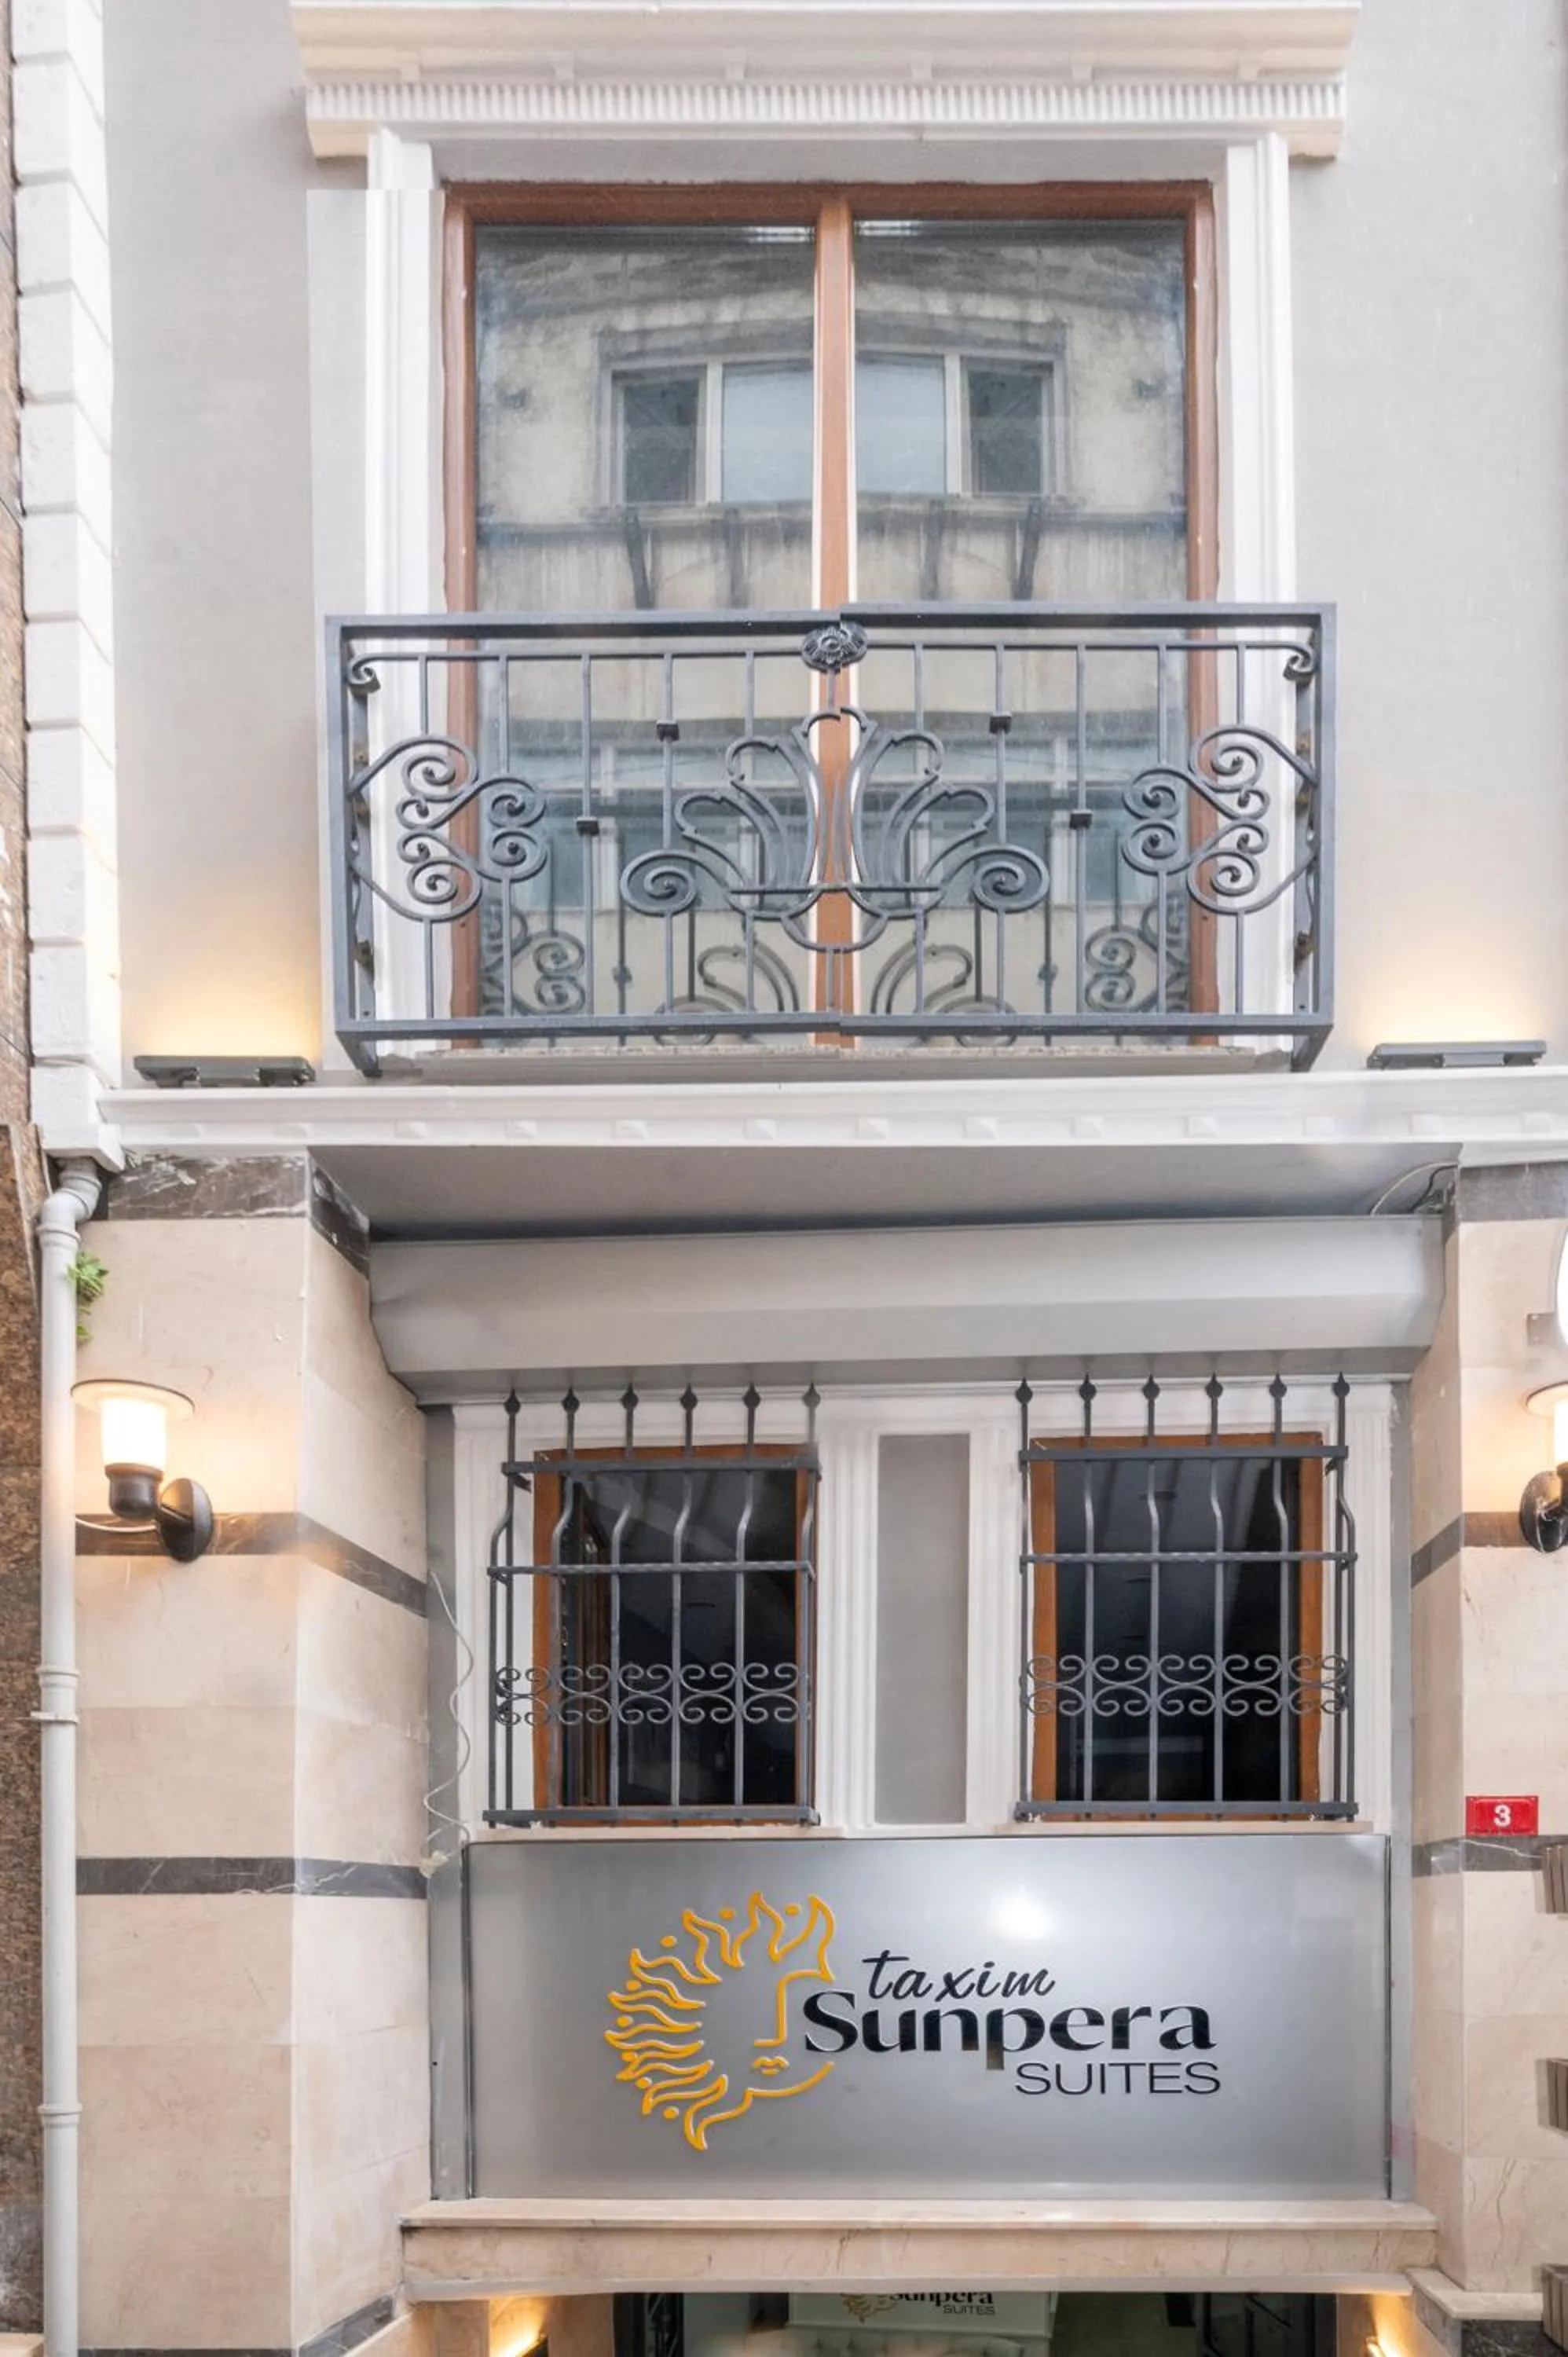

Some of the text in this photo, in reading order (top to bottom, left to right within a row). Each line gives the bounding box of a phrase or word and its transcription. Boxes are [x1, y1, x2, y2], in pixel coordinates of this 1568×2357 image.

[1493, 1804, 1511, 1827] 3
[862, 1949, 1056, 2003] taxim
[803, 1990, 1217, 2070] Sunpera
[1015, 2062, 1221, 2095] SUITES
